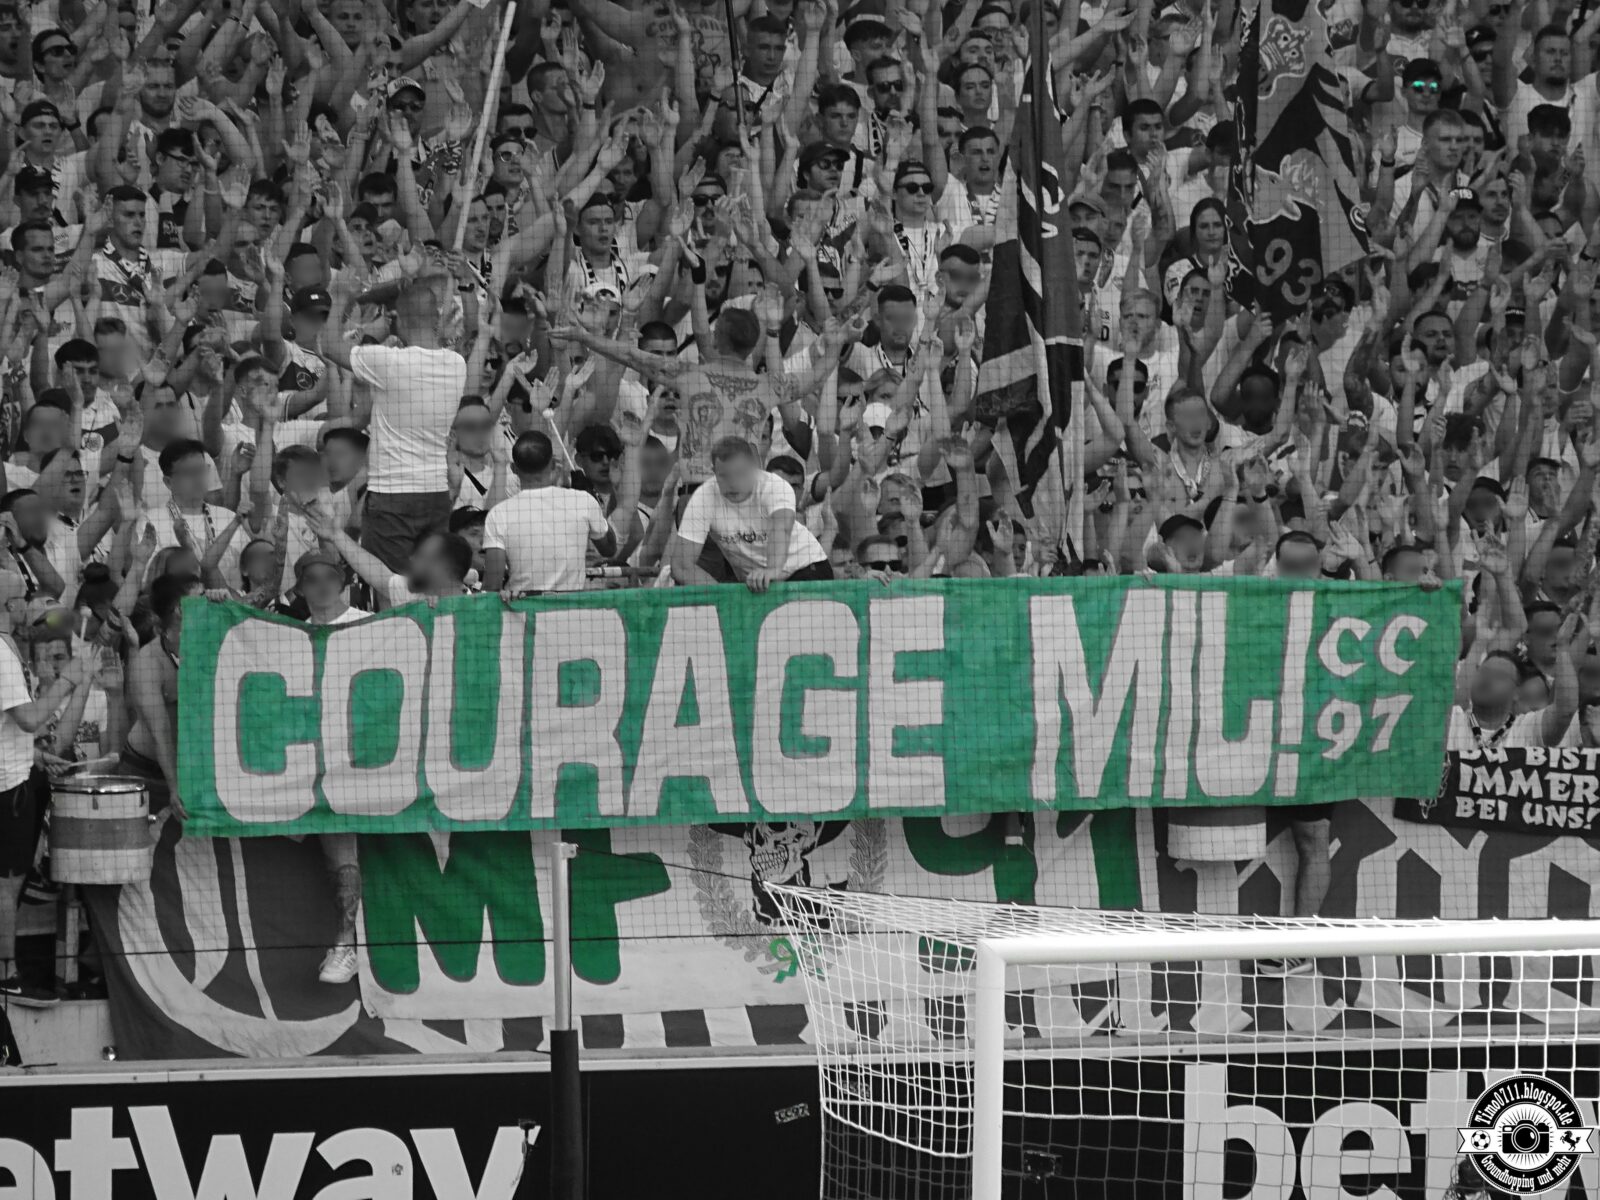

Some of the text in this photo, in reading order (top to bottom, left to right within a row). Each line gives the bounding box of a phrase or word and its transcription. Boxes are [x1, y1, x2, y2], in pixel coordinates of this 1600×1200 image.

[1256, 238, 1322, 305] 93
[1317, 614, 1428, 678] CC
[213, 594, 946, 823] COURAGE
[1316, 693, 1414, 760] 97
[1459, 762, 1600, 805] IMMER
[1525, 746, 1600, 771] BIST
[1455, 796, 1600, 830] BEI UNS!
